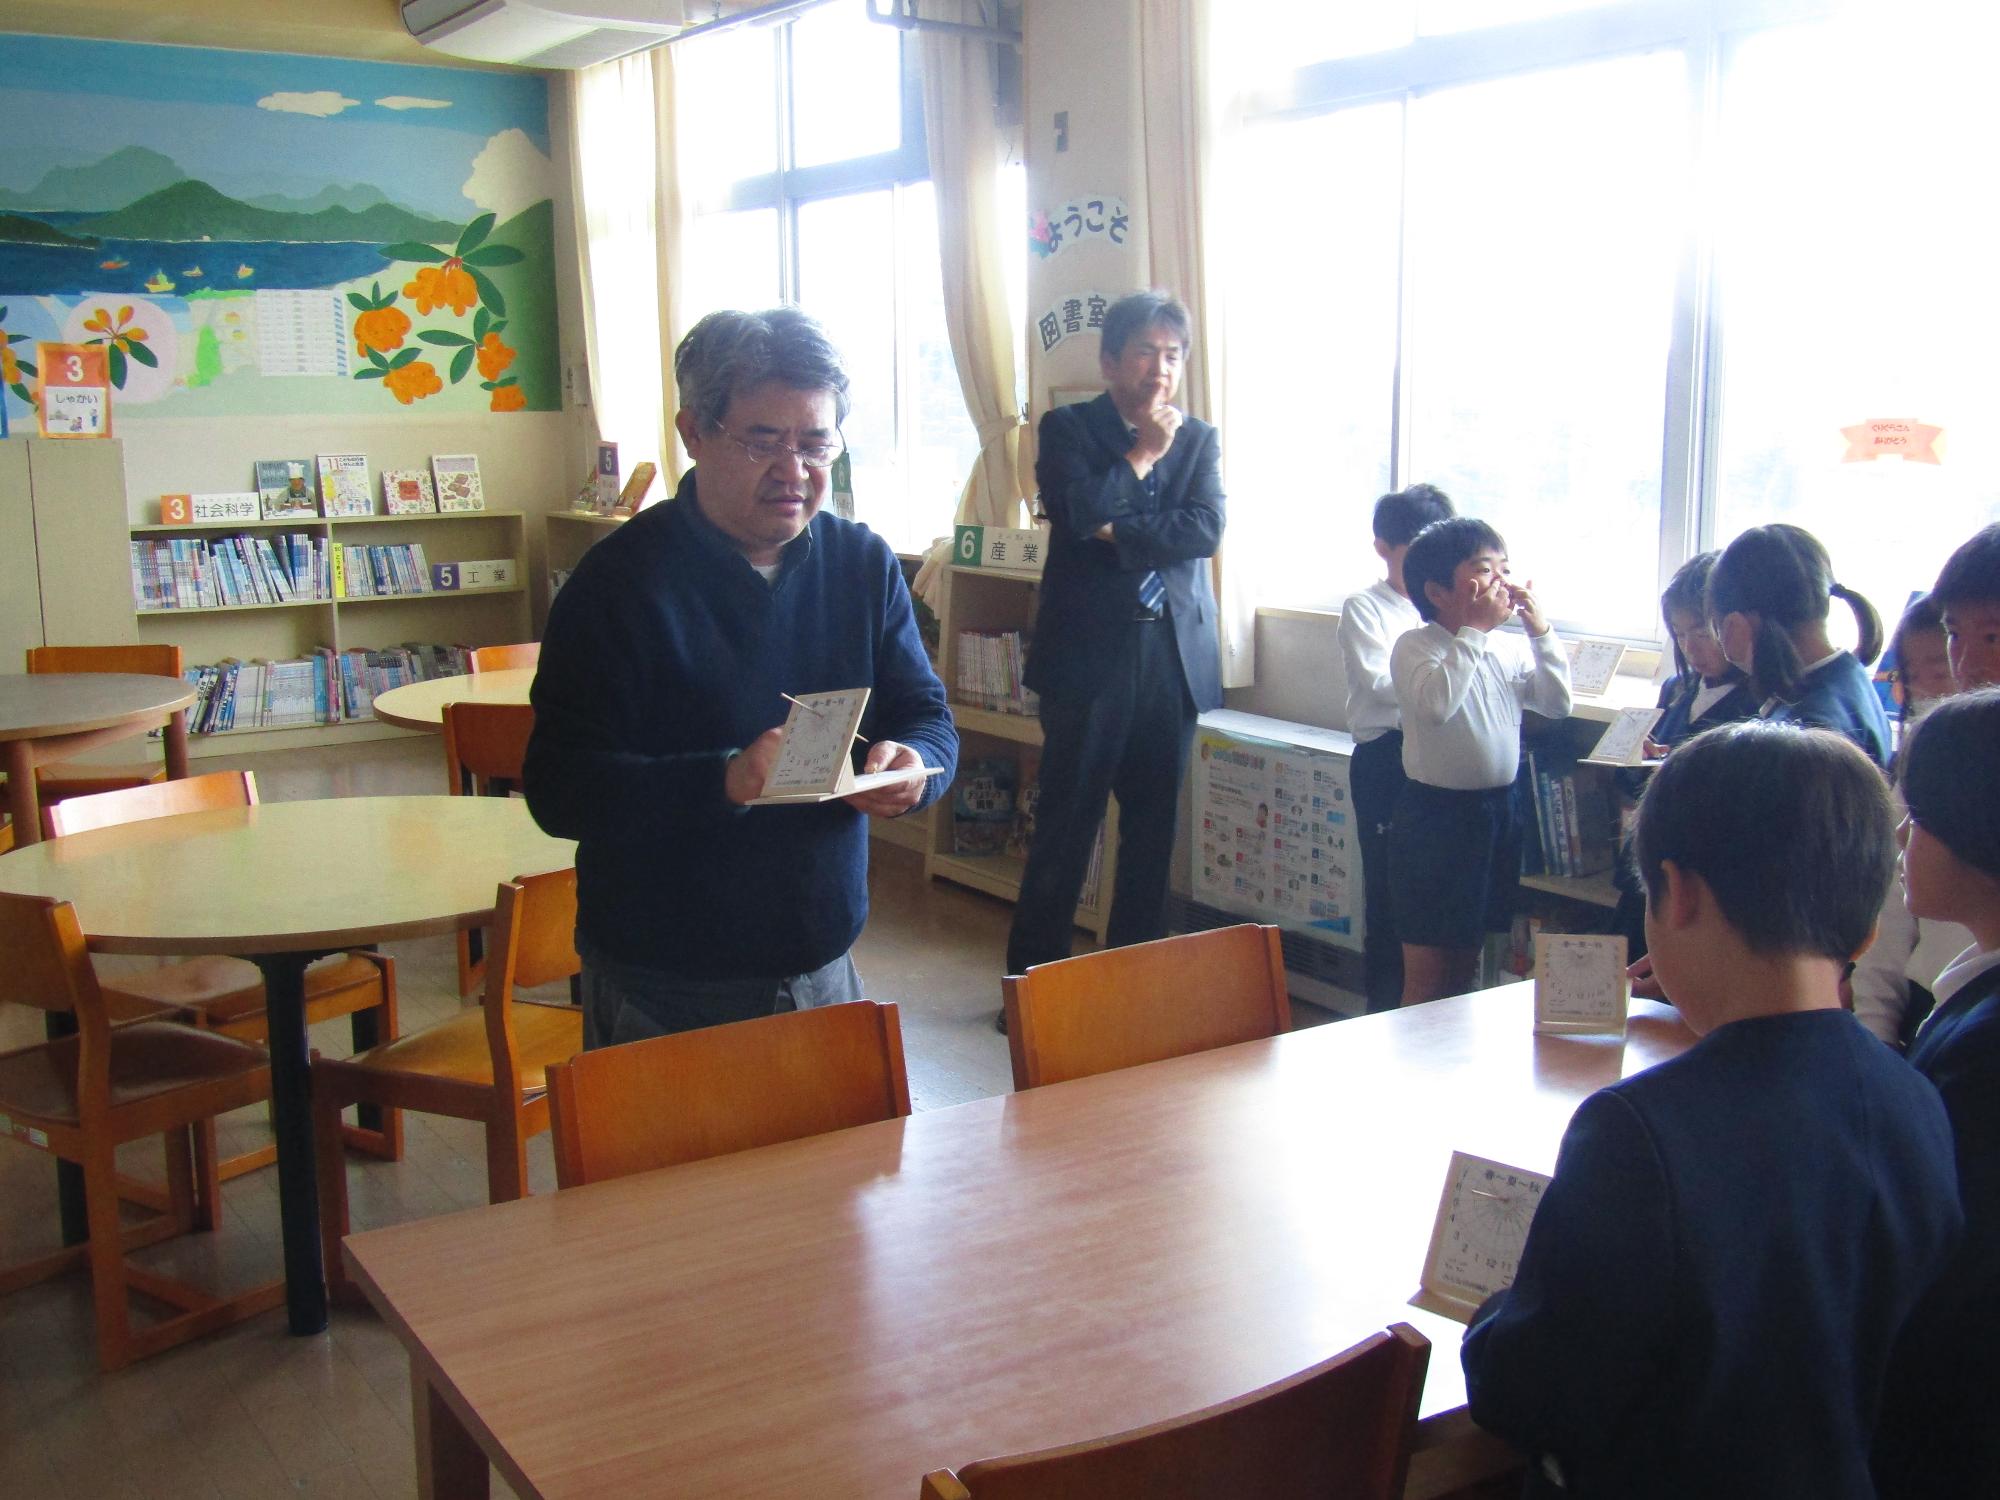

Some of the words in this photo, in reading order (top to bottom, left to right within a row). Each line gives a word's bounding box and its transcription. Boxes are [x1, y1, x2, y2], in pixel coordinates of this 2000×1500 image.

[1048, 200, 1128, 253] ようこそ
[1038, 294, 1107, 352] 図書室
[66, 355, 84, 382] 3
[56, 393, 98, 403] しゃかい
[605, 450, 612, 472] 5
[170, 498, 185, 520] 3
[194, 502, 254, 518] 社会科学
[961, 530, 975, 559] 6
[991, 541, 1038, 563] 産業
[441, 566, 453, 586] 5
[467, 568, 506, 584] 工業
